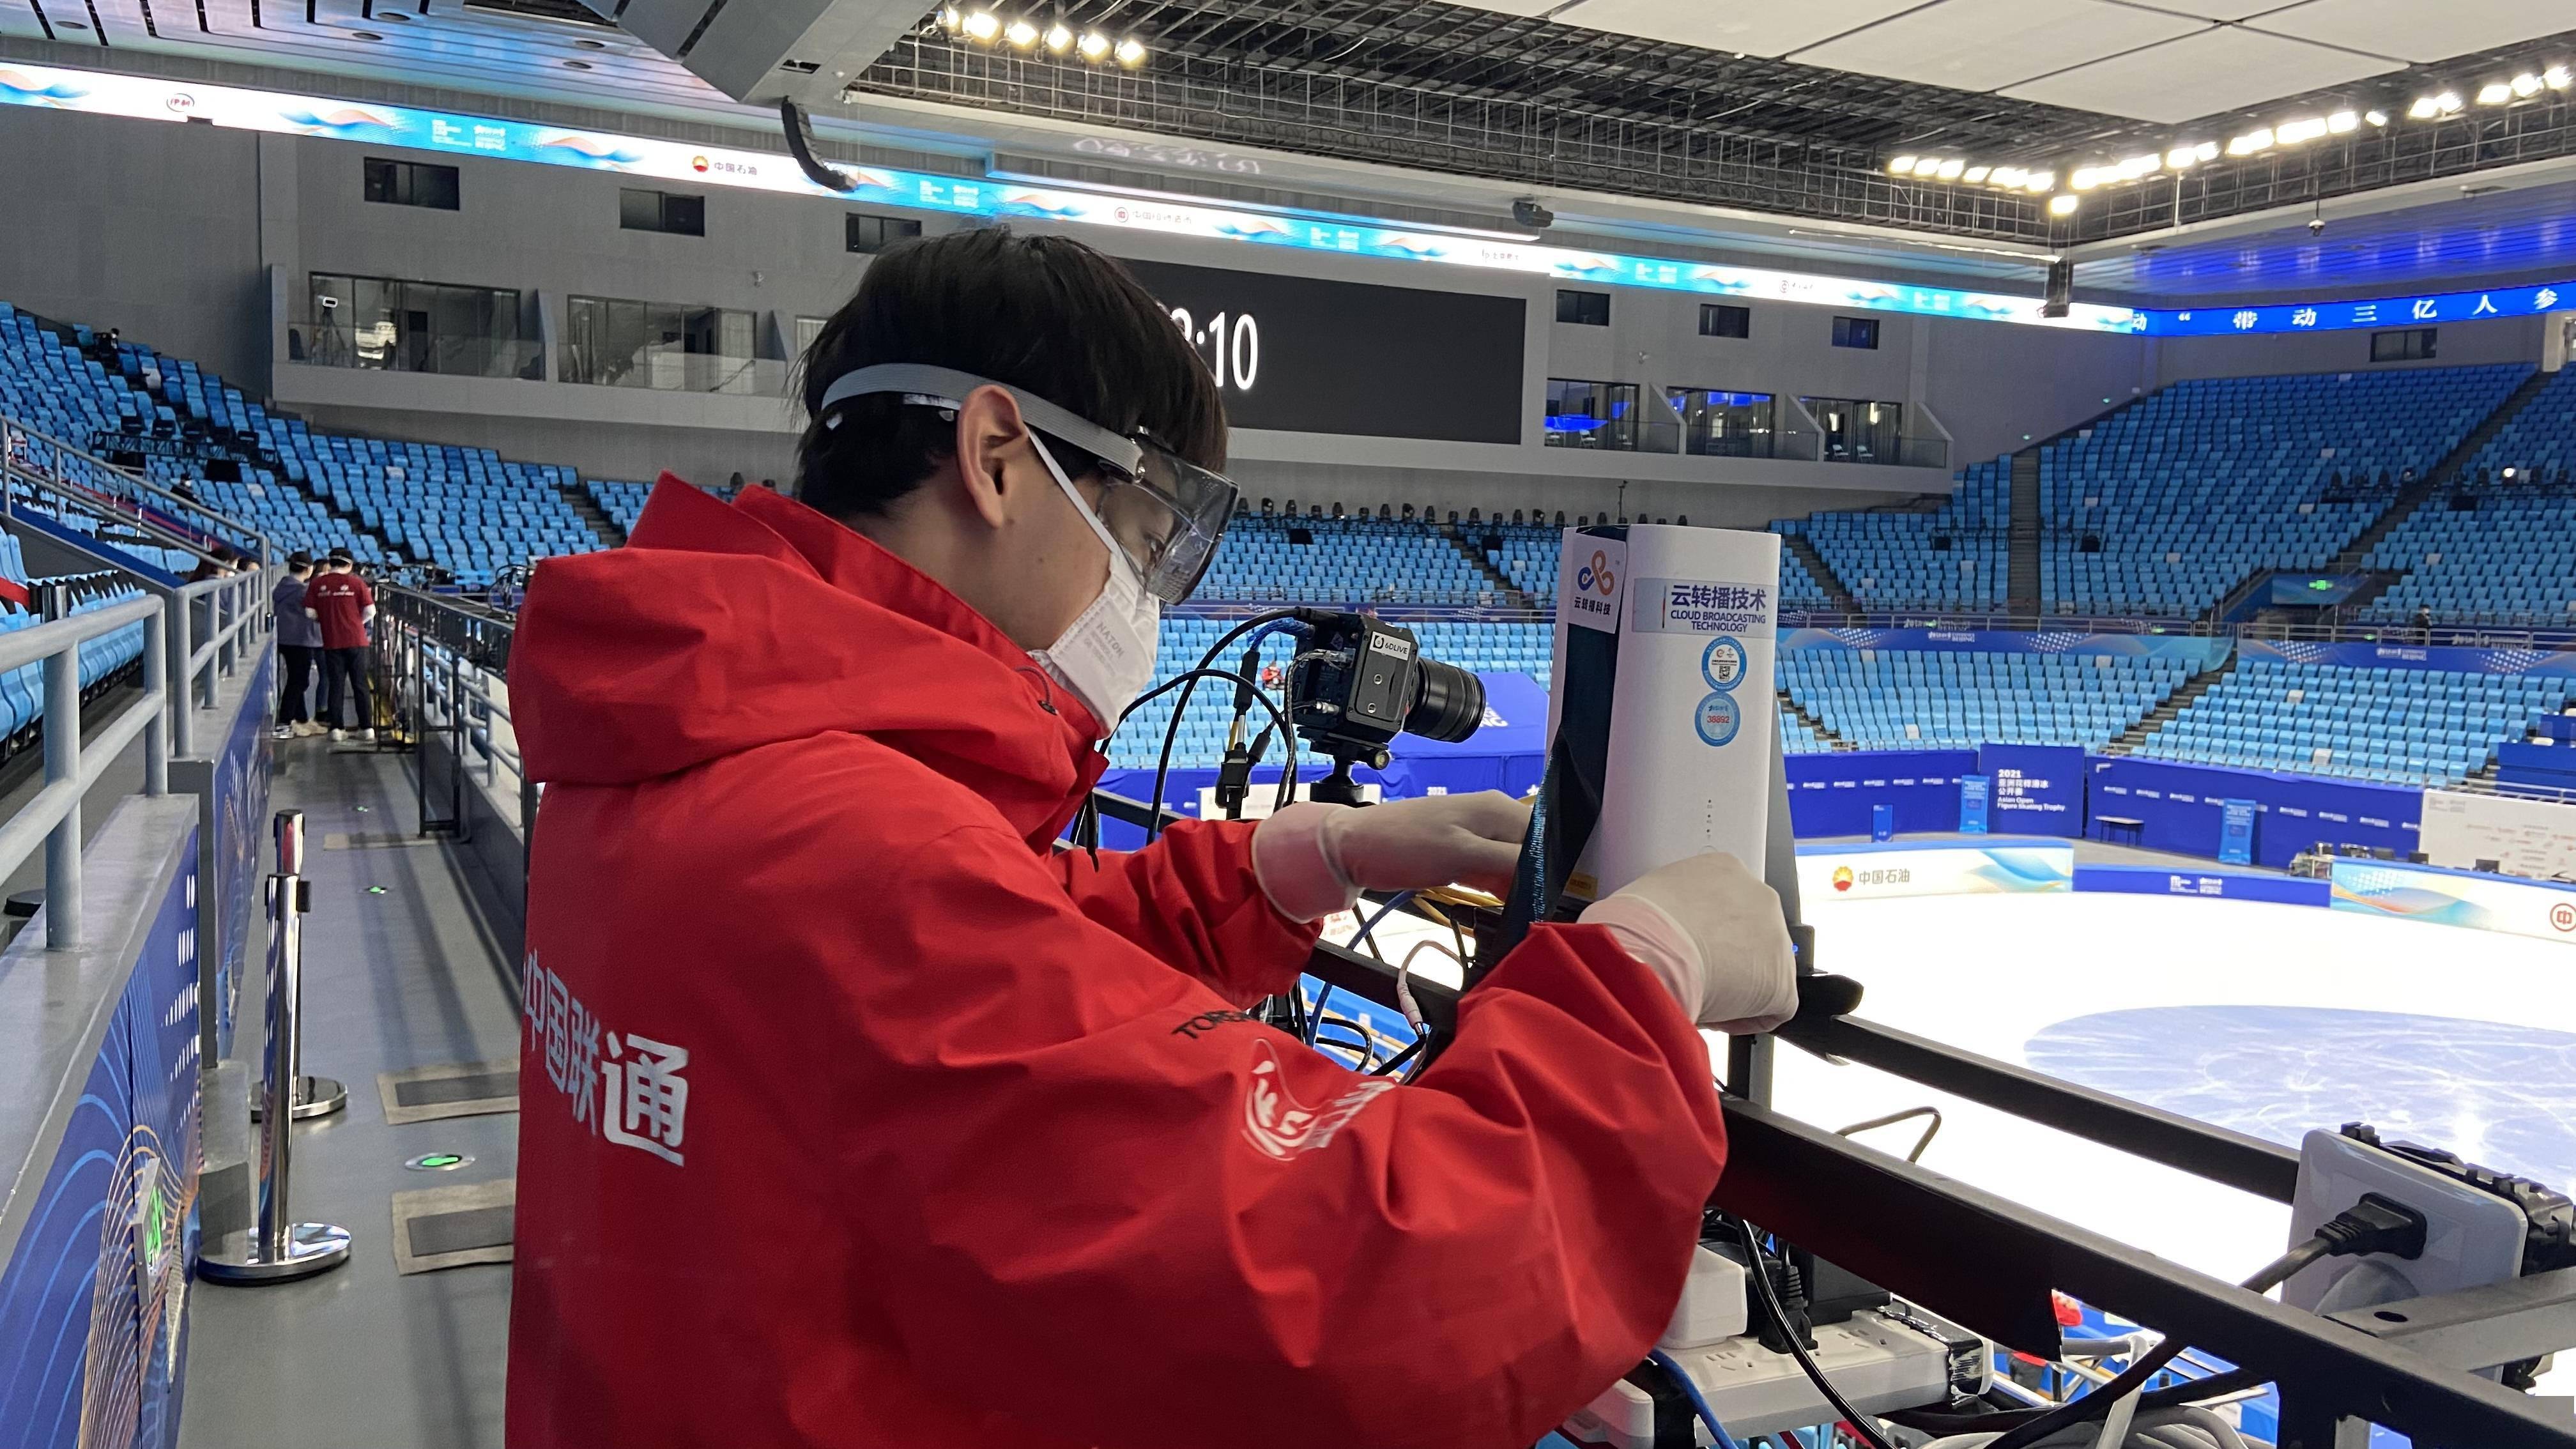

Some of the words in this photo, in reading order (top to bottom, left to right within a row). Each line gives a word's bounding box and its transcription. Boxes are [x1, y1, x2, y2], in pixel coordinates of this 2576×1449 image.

[1574, 596, 1611, 616] 云转播科技
[1671, 585, 1767, 611] 云转播技术
[1671, 610, 1701, 620] CLOUD
[1703, 611, 1766, 624] BROADCASTING
[1691, 621, 1748, 632] TECHNOLOGY
[1096, 622, 1124, 659] NATON
[1385, 643, 1408, 655] 6DLIVE
[1998, 769, 2021, 778] 2021
[1859, 868, 1910, 885] 中国石油
[523, 947, 688, 1167] 中国联通
